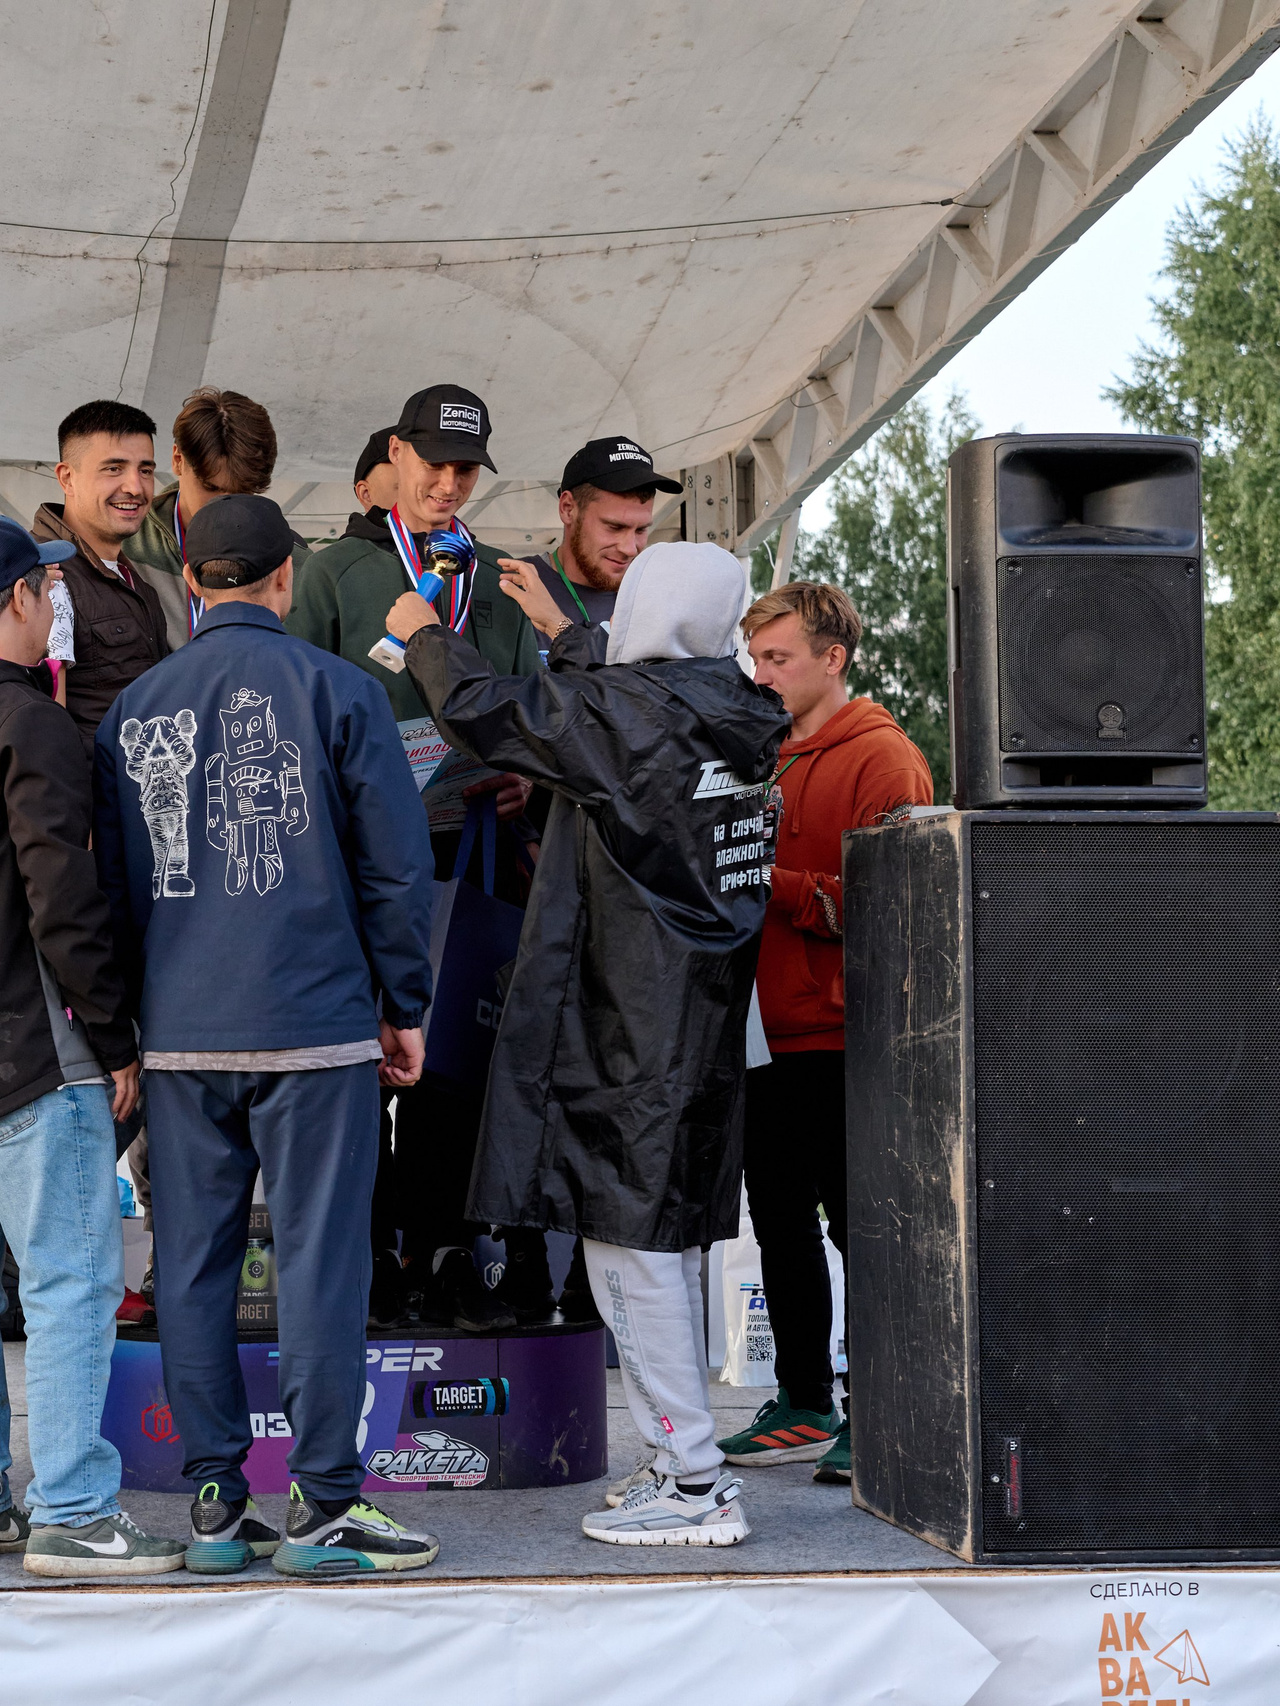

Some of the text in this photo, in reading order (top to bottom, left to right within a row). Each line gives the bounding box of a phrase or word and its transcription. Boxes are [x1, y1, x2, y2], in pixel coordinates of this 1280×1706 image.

[443, 407, 478, 422] Zenich
[720, 867, 761, 893] дрифта
[237, 1304, 271, 1320] RGET
[605, 1268, 631, 1341] SERIES
[433, 1386, 485, 1405] TARGET
[367, 1450, 488, 1475] РАКЕТА
[400, 1473, 486, 1482] СПОРТИВНО-ТЕХНИЧЕСКИЙ
[1090, 1582, 1200, 1600] СДЕЛАНО В
[1098, 1611, 1151, 1652] АК
[1098, 1656, 1151, 1697] ВА
